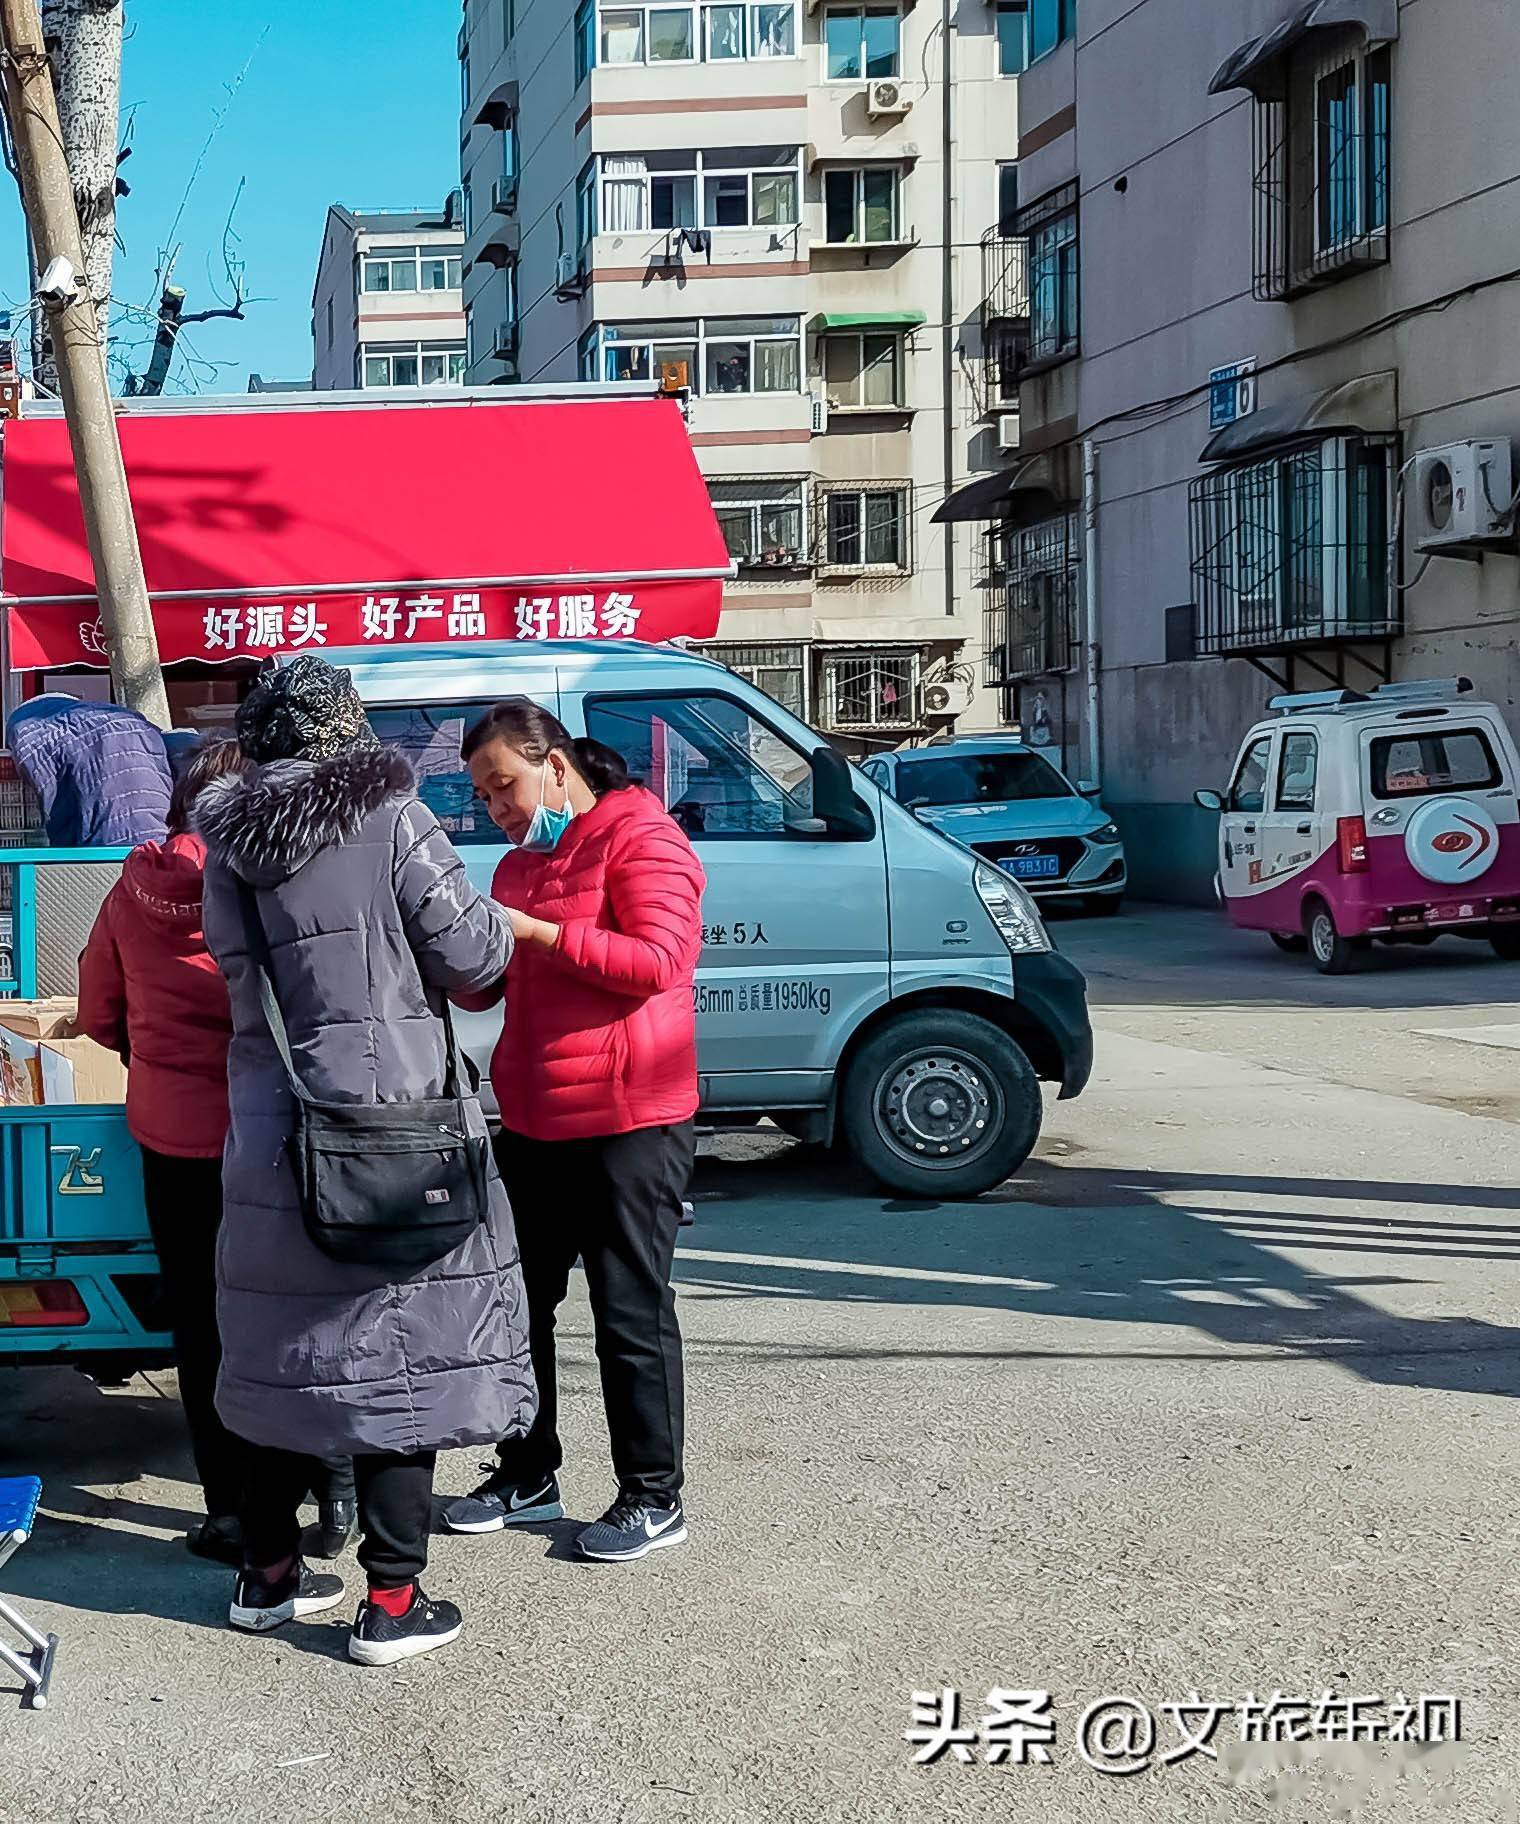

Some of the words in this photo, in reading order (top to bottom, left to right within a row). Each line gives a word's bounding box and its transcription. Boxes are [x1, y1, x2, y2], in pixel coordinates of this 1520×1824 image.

[202, 603, 328, 650] 好源头
[361, 592, 486, 639] 好产品
[514, 591, 642, 640] 好服务
